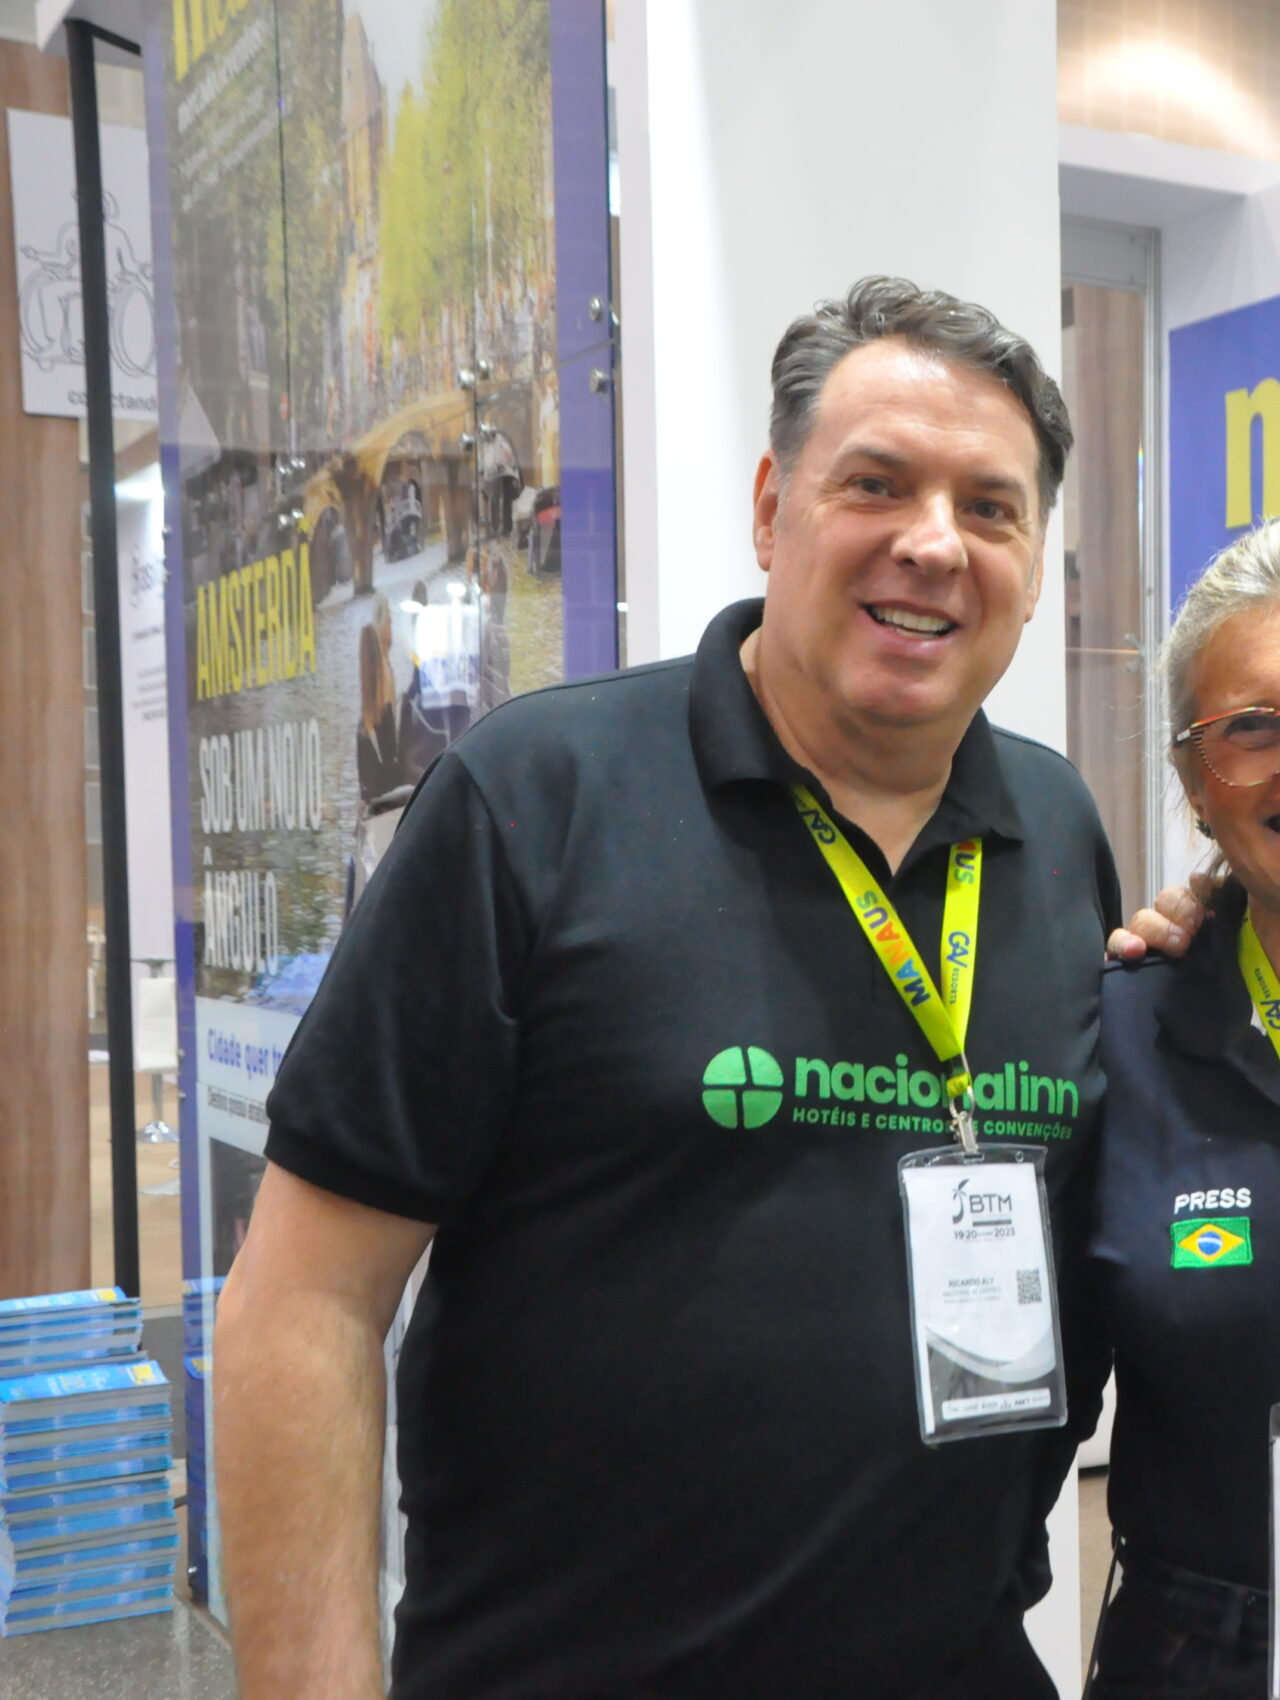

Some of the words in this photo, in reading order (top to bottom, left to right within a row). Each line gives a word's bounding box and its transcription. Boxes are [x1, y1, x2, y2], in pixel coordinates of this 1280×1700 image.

[856, 890, 930, 1007] MANAUS
[793, 1106, 856, 1127] HOTÉIS
[861, 1113, 871, 1128] E
[875, 1114, 951, 1134] CENTRO
[983, 1120, 1073, 1141] CONVENÇÕES
[969, 1193, 1012, 1214] BTM
[1174, 1187, 1252, 1215] PRESS
